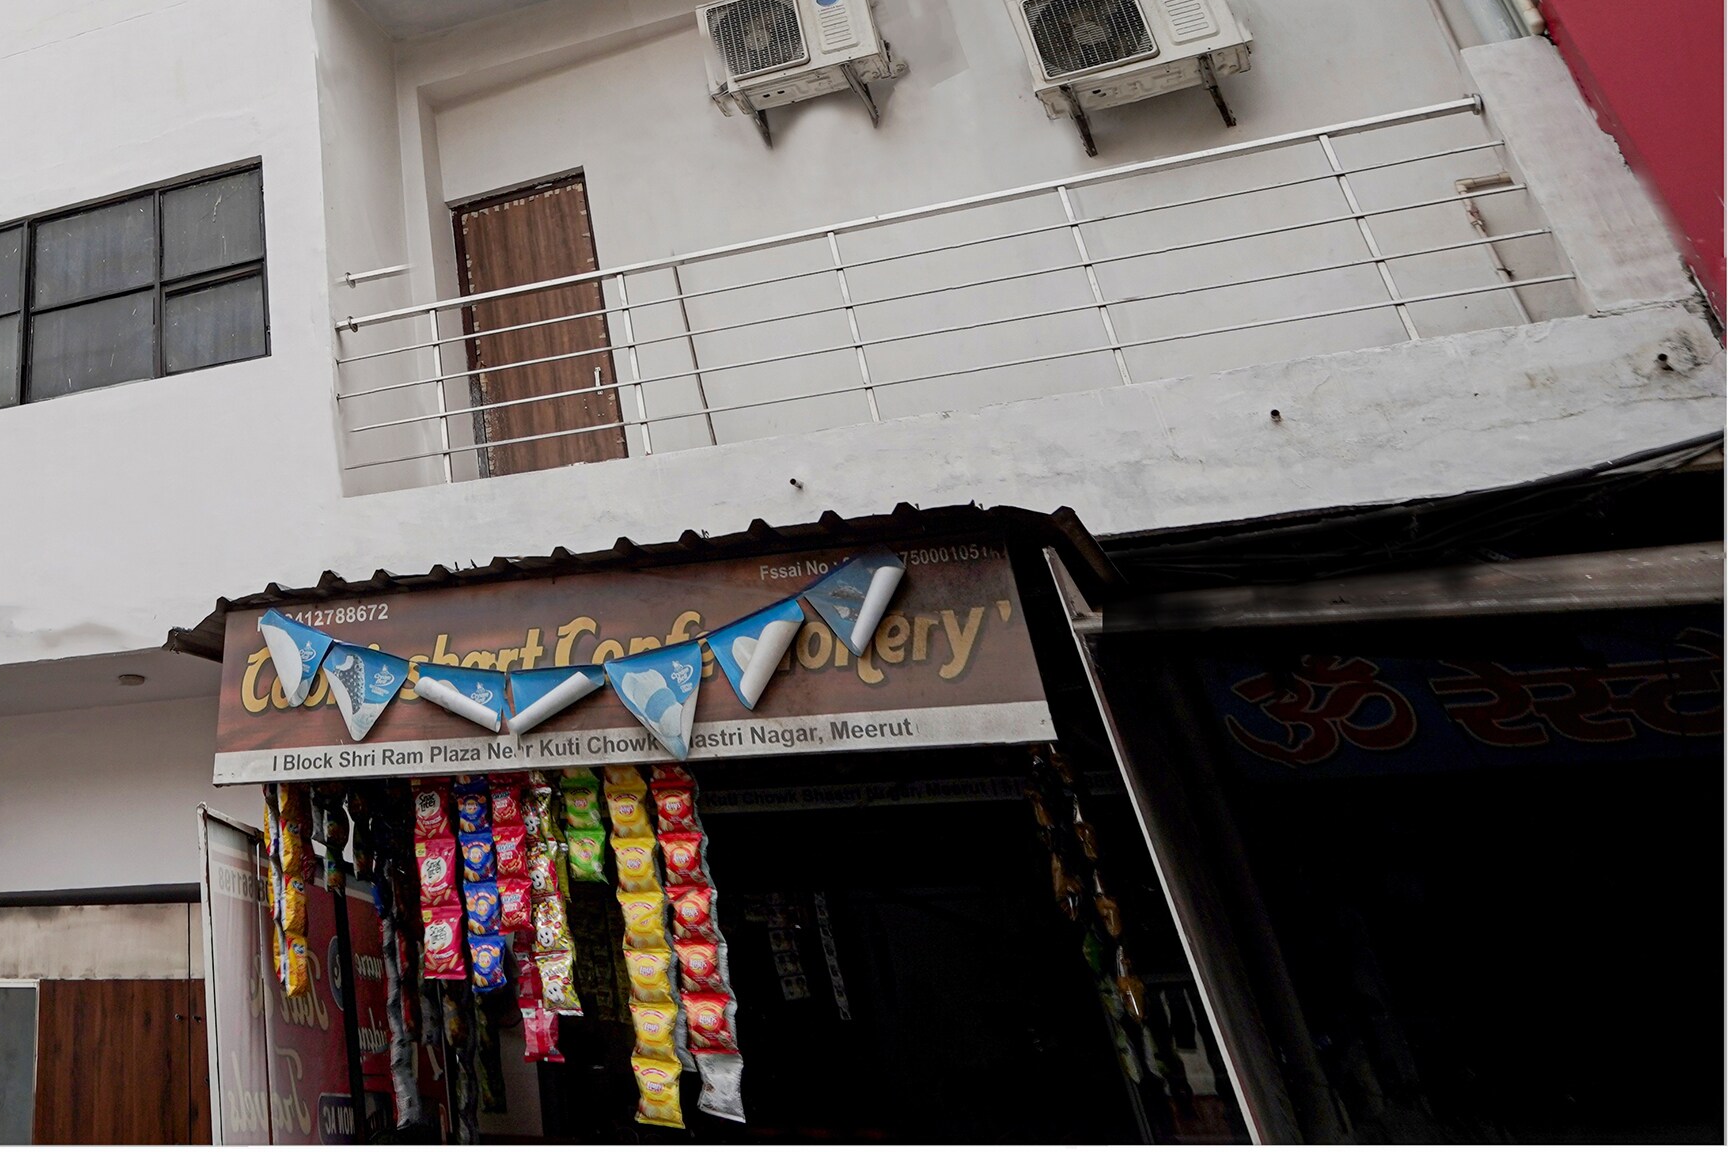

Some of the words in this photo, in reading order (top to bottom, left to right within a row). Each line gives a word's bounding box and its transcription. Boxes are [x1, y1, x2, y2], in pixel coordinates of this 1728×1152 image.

[759, 562, 803, 581] Fssai
[283, 753, 333, 771] Block
[339, 750, 375, 768] Shri
[382, 748, 423, 765] Ram
[430, 746, 481, 762] Plaza
[539, 737, 580, 757] Kuti
[593, 732, 658, 753] Chowk
[690, 727, 743, 748] astri
[751, 724, 824, 747] Nagar,
[830, 718, 914, 740] Meerut
